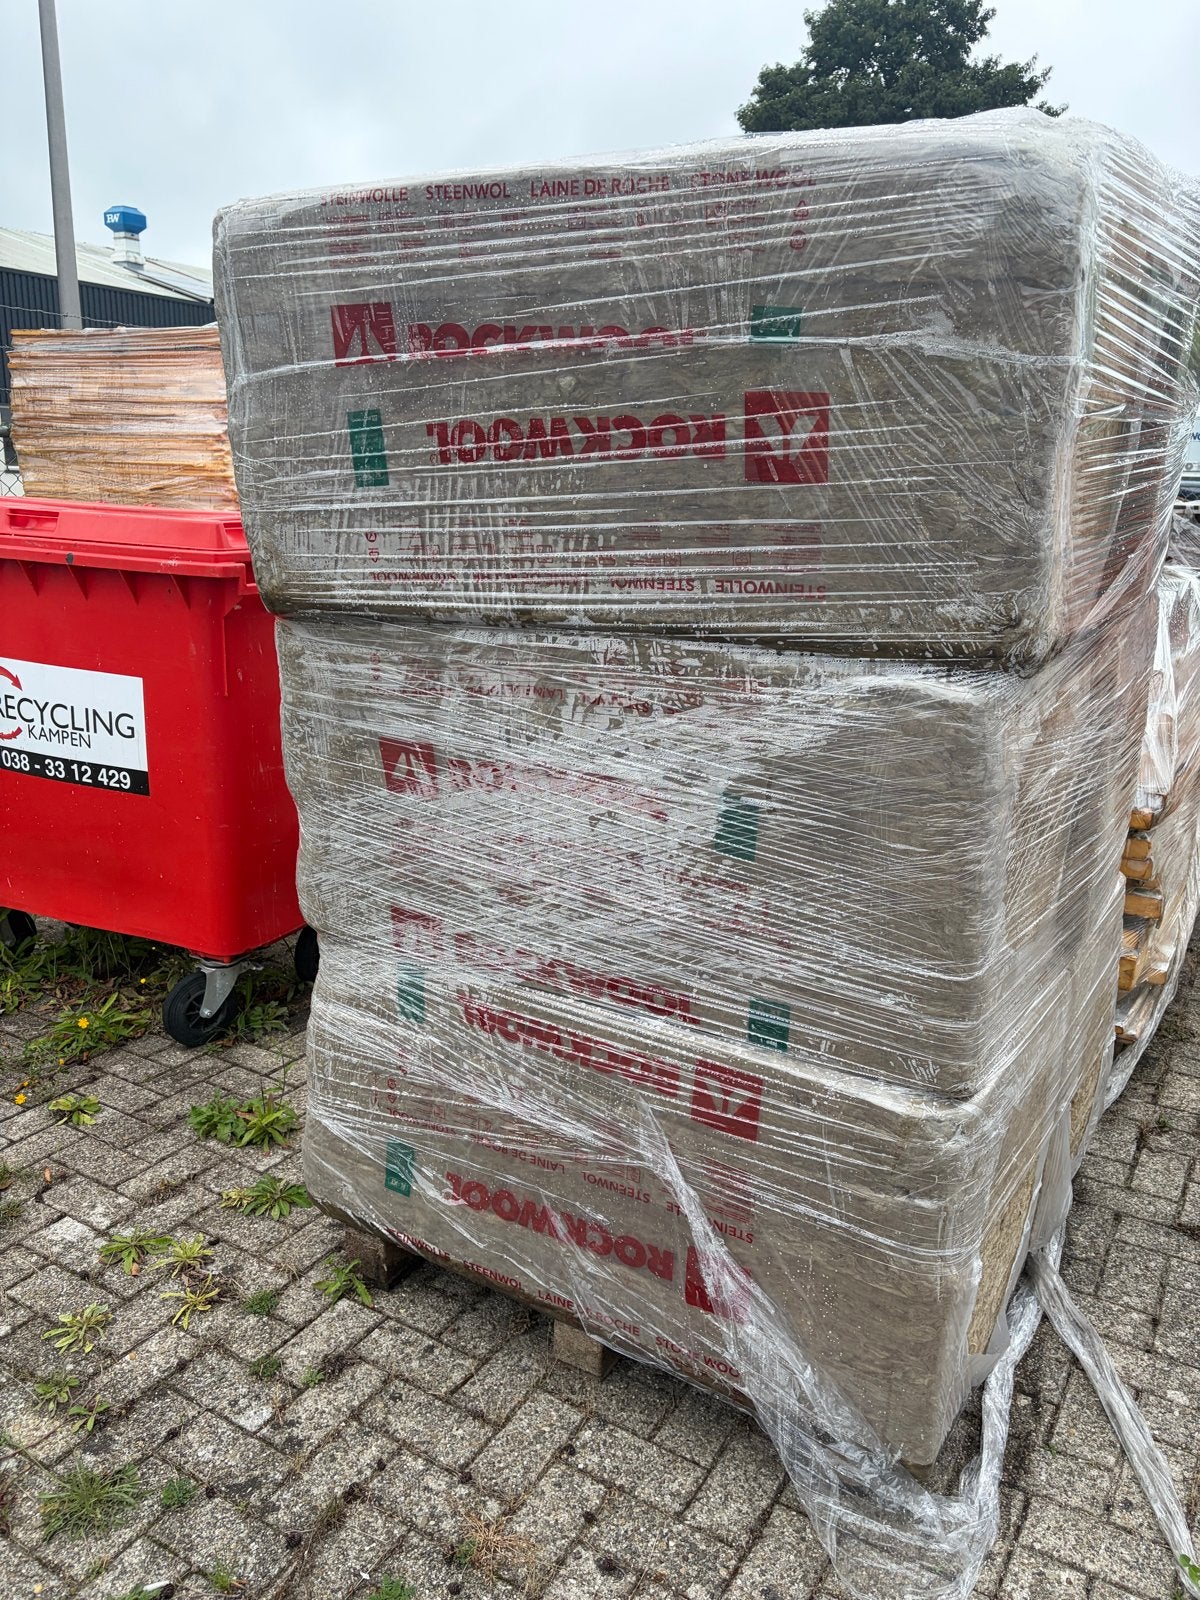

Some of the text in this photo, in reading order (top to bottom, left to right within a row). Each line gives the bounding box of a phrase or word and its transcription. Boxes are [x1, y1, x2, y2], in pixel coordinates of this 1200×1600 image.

[426, 182, 511, 200] STEENWOL
[531, 180, 580, 197] LAINE
[584, 179, 607, 195] DE
[427, 414, 726, 464] ROCKWOOL
[27, 724, 92, 749] KAMPEN
[2, 750, 30, 771] 038
[44, 759, 66, 779] 33
[71, 763, 92, 783] 12
[98, 768, 131, 789] 429
[511, 1147, 527, 1161] DE
[529, 1156, 565, 1174] LAINE
[581, 1171, 650, 1204] STEENWOL
[446, 1171, 674, 1281] ROCKWOOL
[538, 1289, 575, 1311] LAINE
